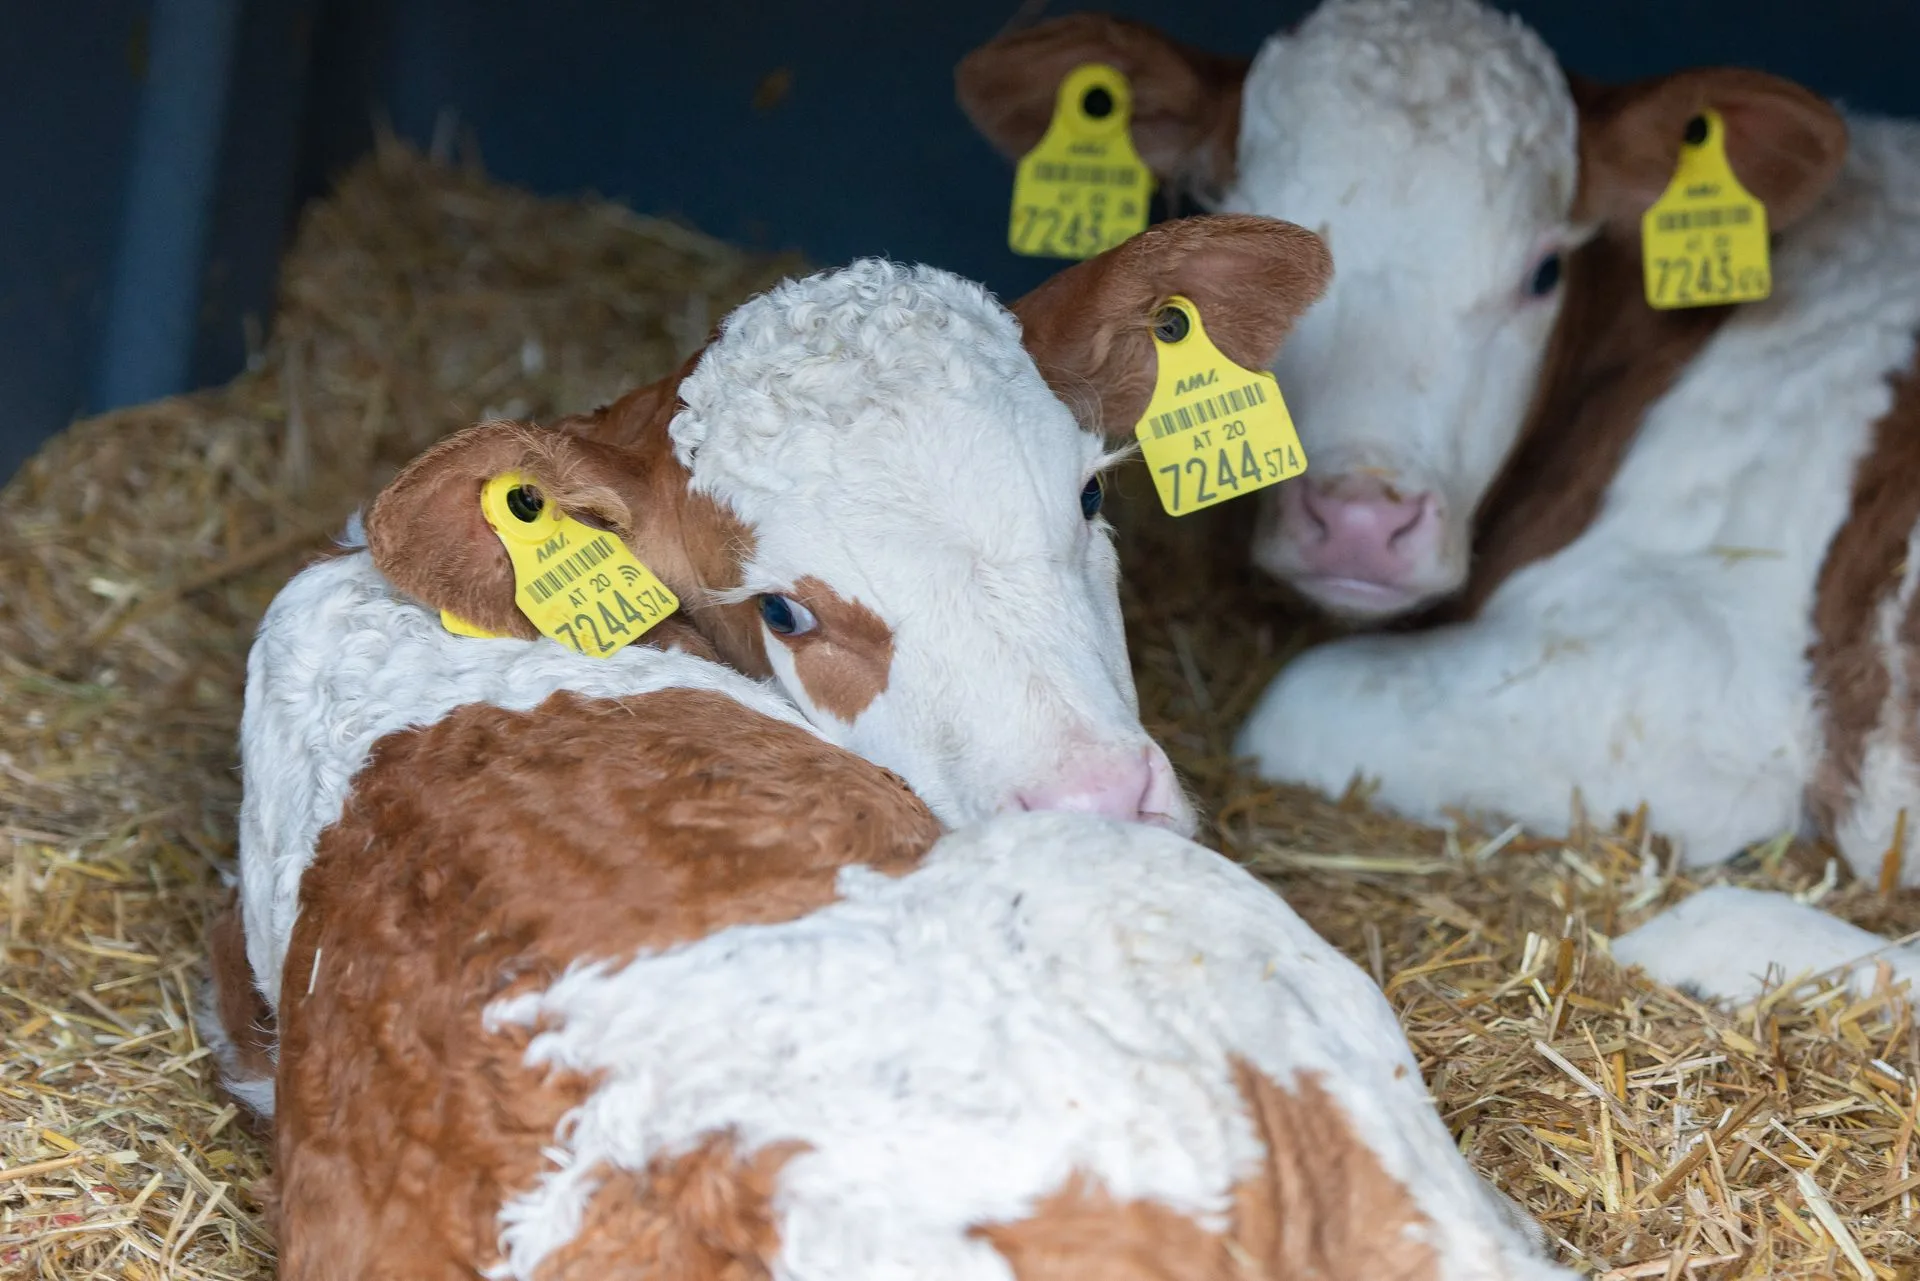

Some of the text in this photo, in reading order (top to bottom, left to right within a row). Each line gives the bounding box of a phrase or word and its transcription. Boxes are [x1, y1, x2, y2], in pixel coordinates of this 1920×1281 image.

[1193, 420, 1246, 450] AT 20
[1159, 440, 1299, 511] 7244 574
[568, 573, 611, 608] AT 20
[555, 585, 672, 653] 7244 574
